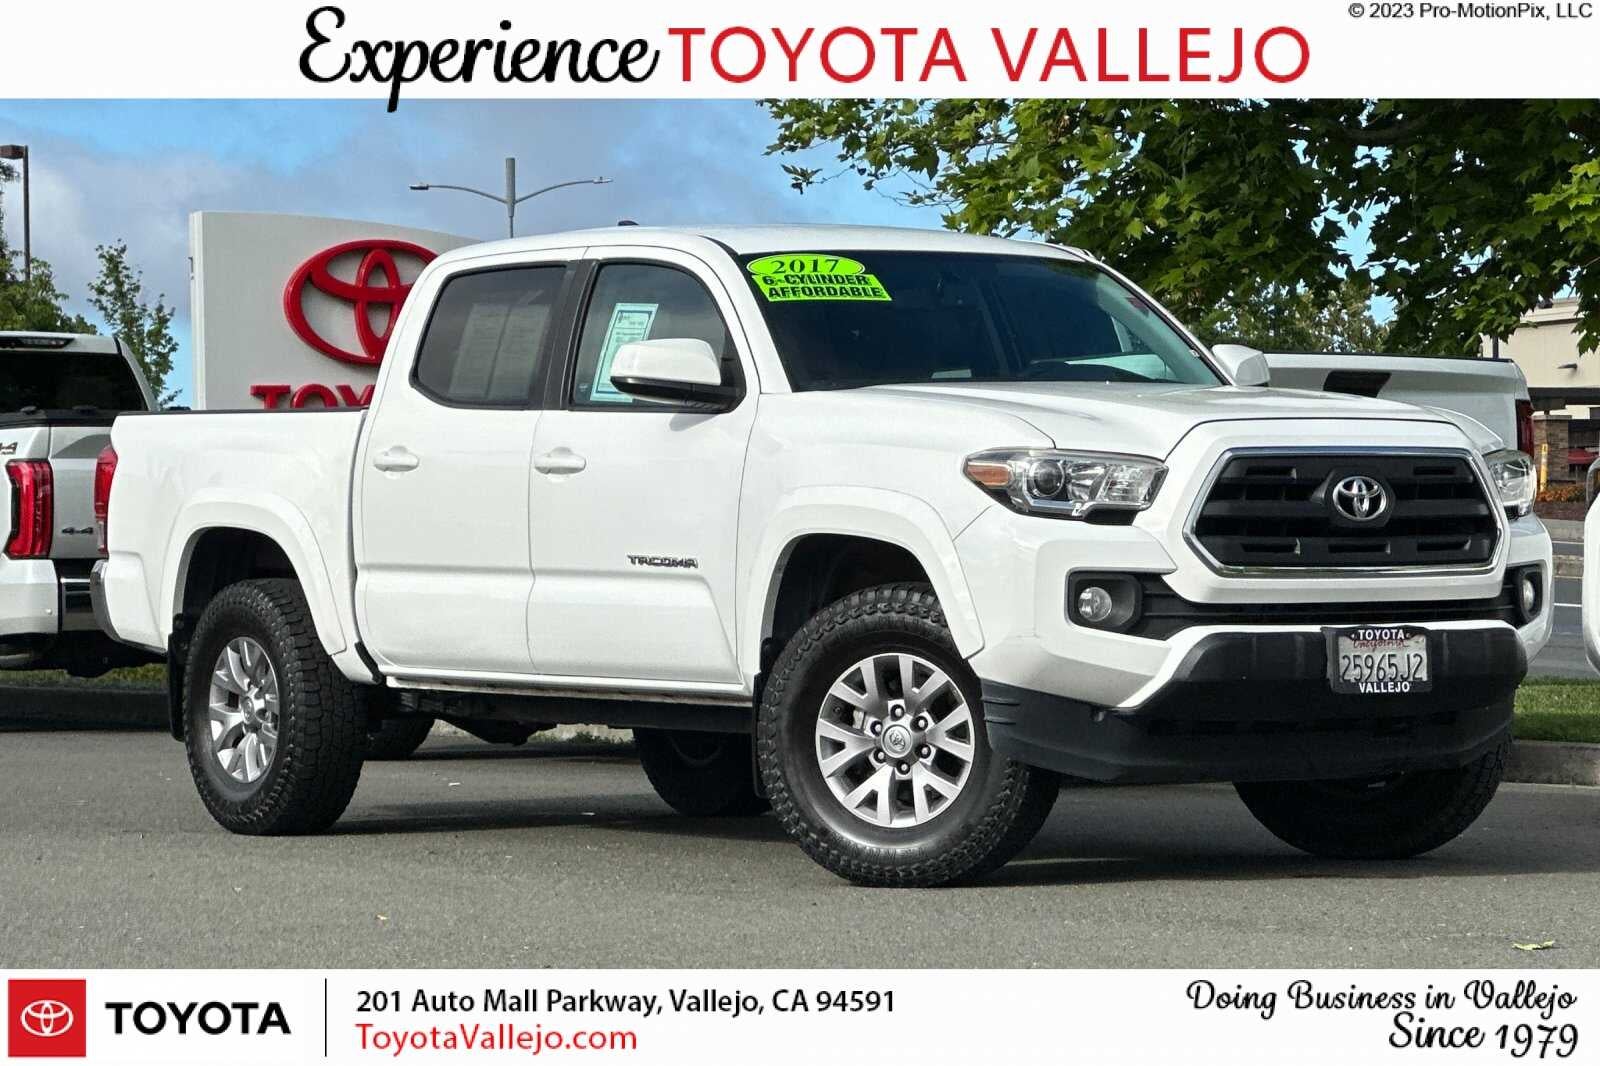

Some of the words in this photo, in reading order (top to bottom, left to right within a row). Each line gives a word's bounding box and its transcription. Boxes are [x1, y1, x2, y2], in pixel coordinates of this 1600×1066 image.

[770, 258, 841, 274] 2017
[761, 273, 869, 286] 6-CYLINDER
[768, 286, 884, 299] AFFORDABLE
[627, 555, 698, 568] TACOMA
[1358, 629, 1405, 640] TOYOTA
[1342, 653, 1423, 681] 25965J2
[1358, 681, 1411, 693] VALLEJO
